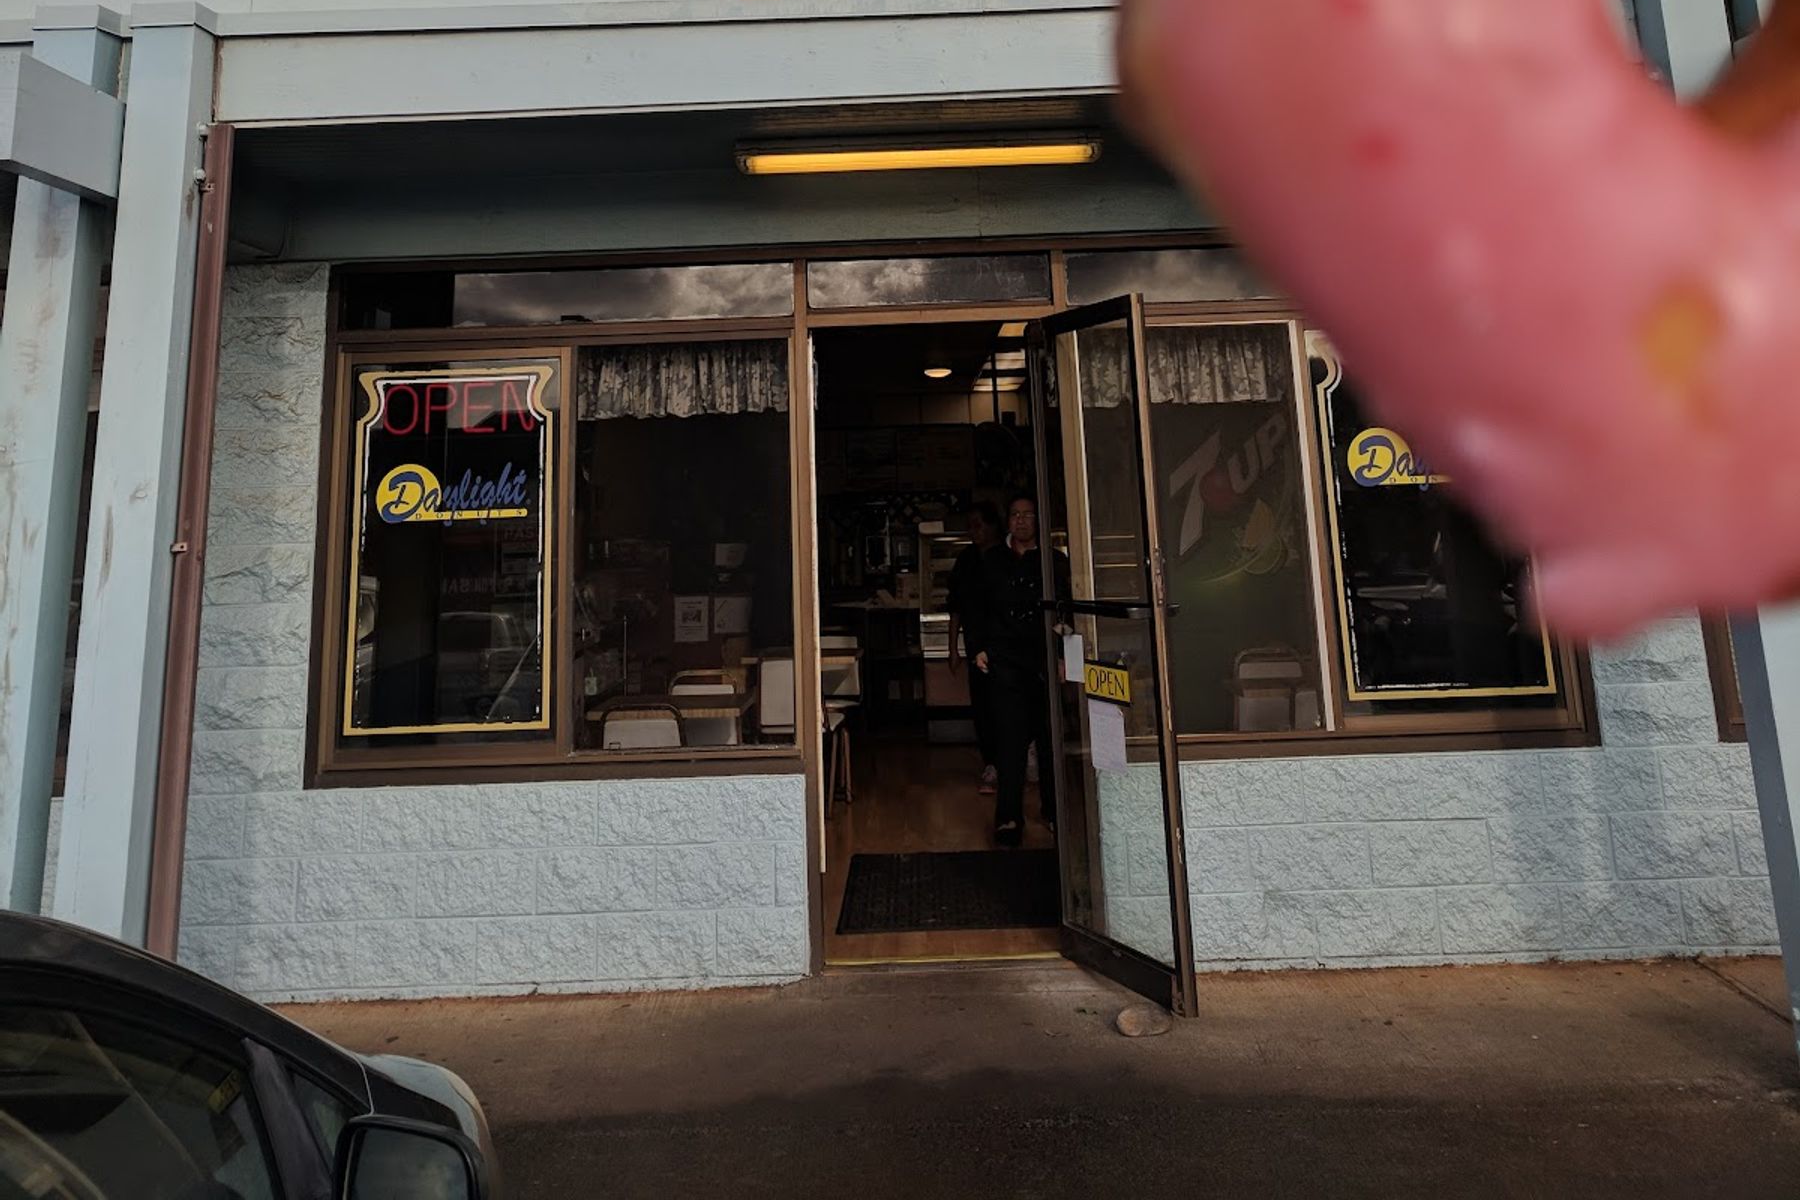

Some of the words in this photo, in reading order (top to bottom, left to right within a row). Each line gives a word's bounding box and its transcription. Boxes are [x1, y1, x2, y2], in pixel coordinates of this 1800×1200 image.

[383, 381, 536, 436] OPEN
[381, 462, 528, 527] Daylight
[1088, 667, 1126, 699] OPEN
